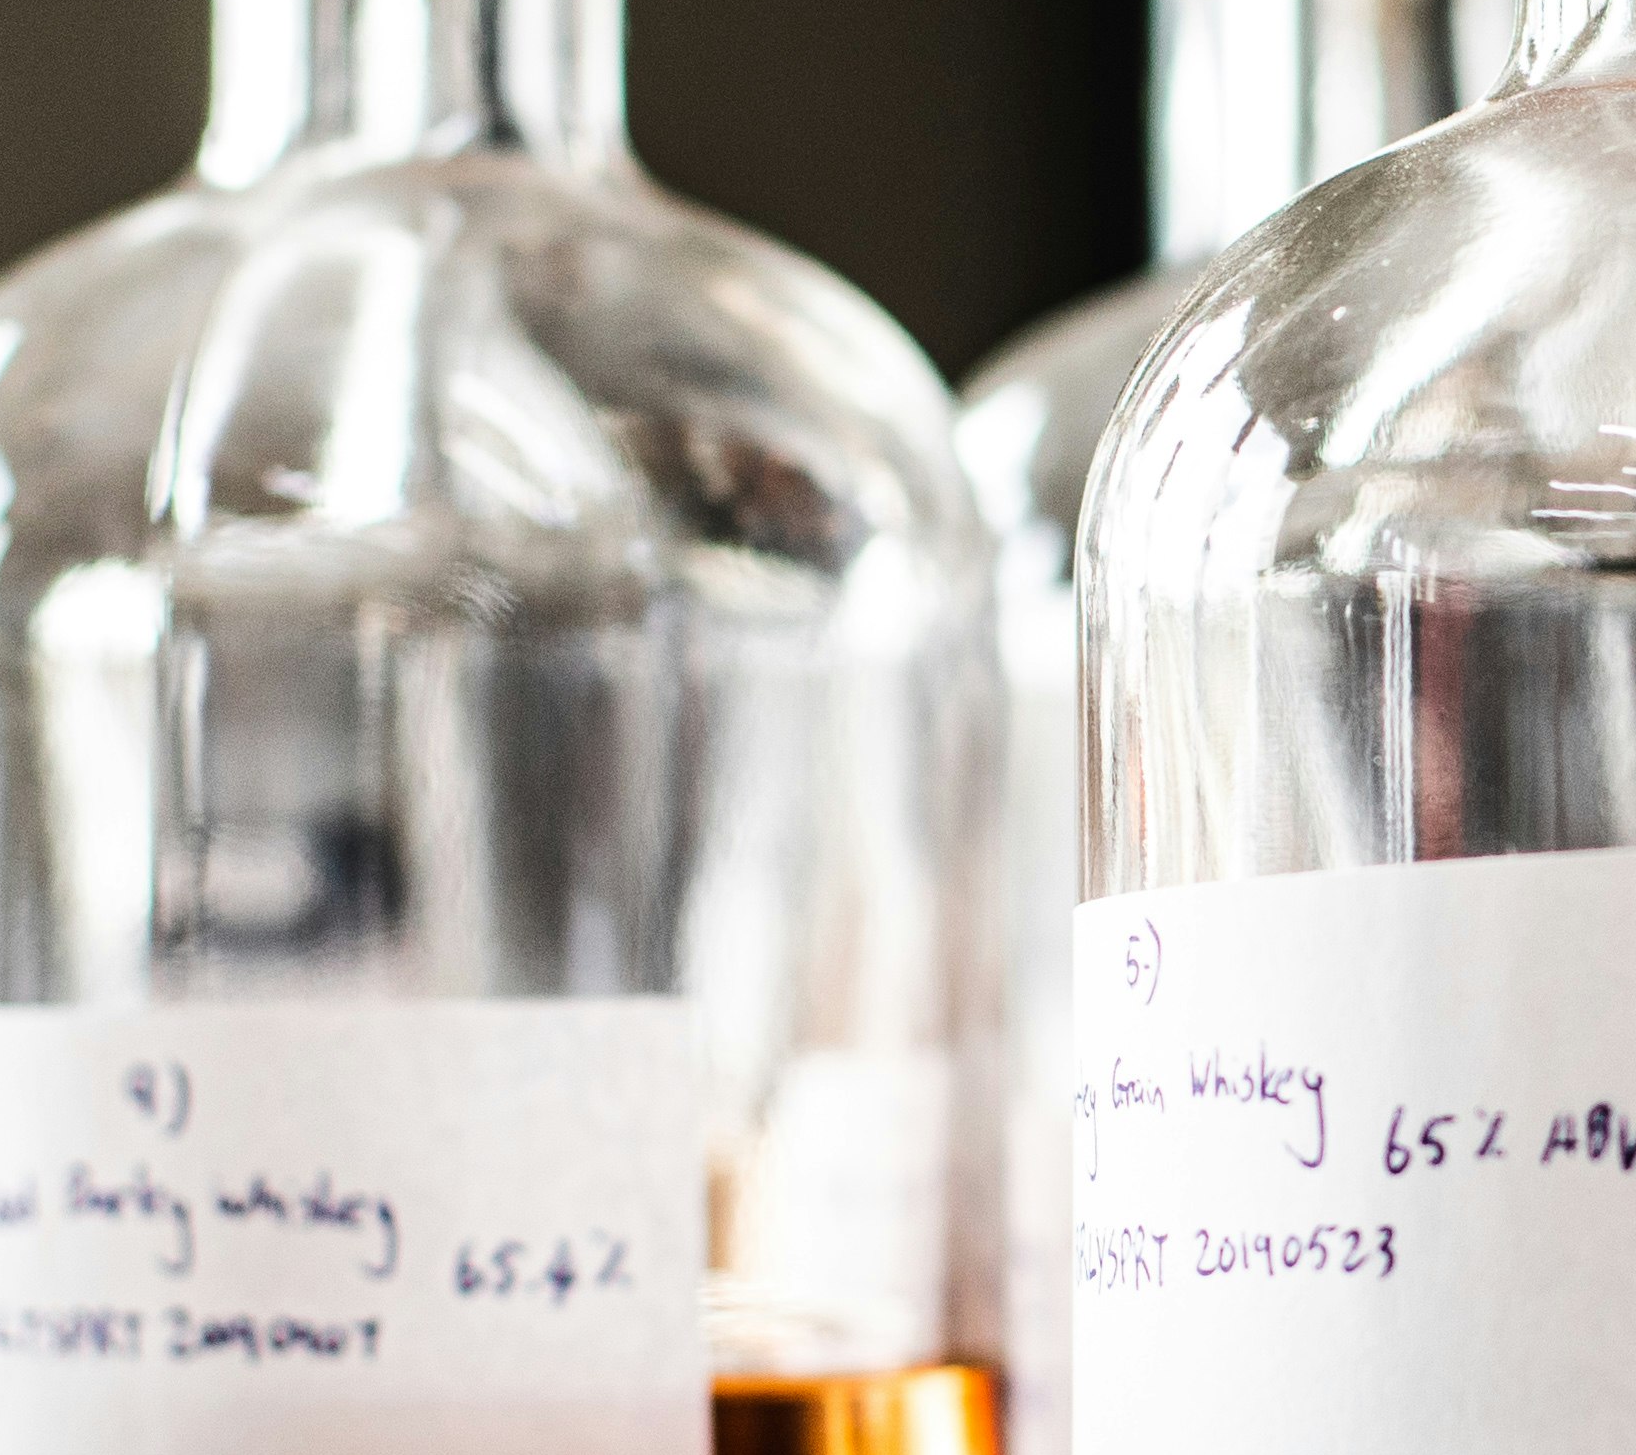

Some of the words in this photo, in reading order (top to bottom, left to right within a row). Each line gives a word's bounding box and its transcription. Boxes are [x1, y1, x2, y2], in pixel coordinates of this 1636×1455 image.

[1111, 1055, 1165, 1115] Grain
[1189, 1039, 1325, 1169] Whiskey
[1194, 1223, 1397, 1280] 20190523
